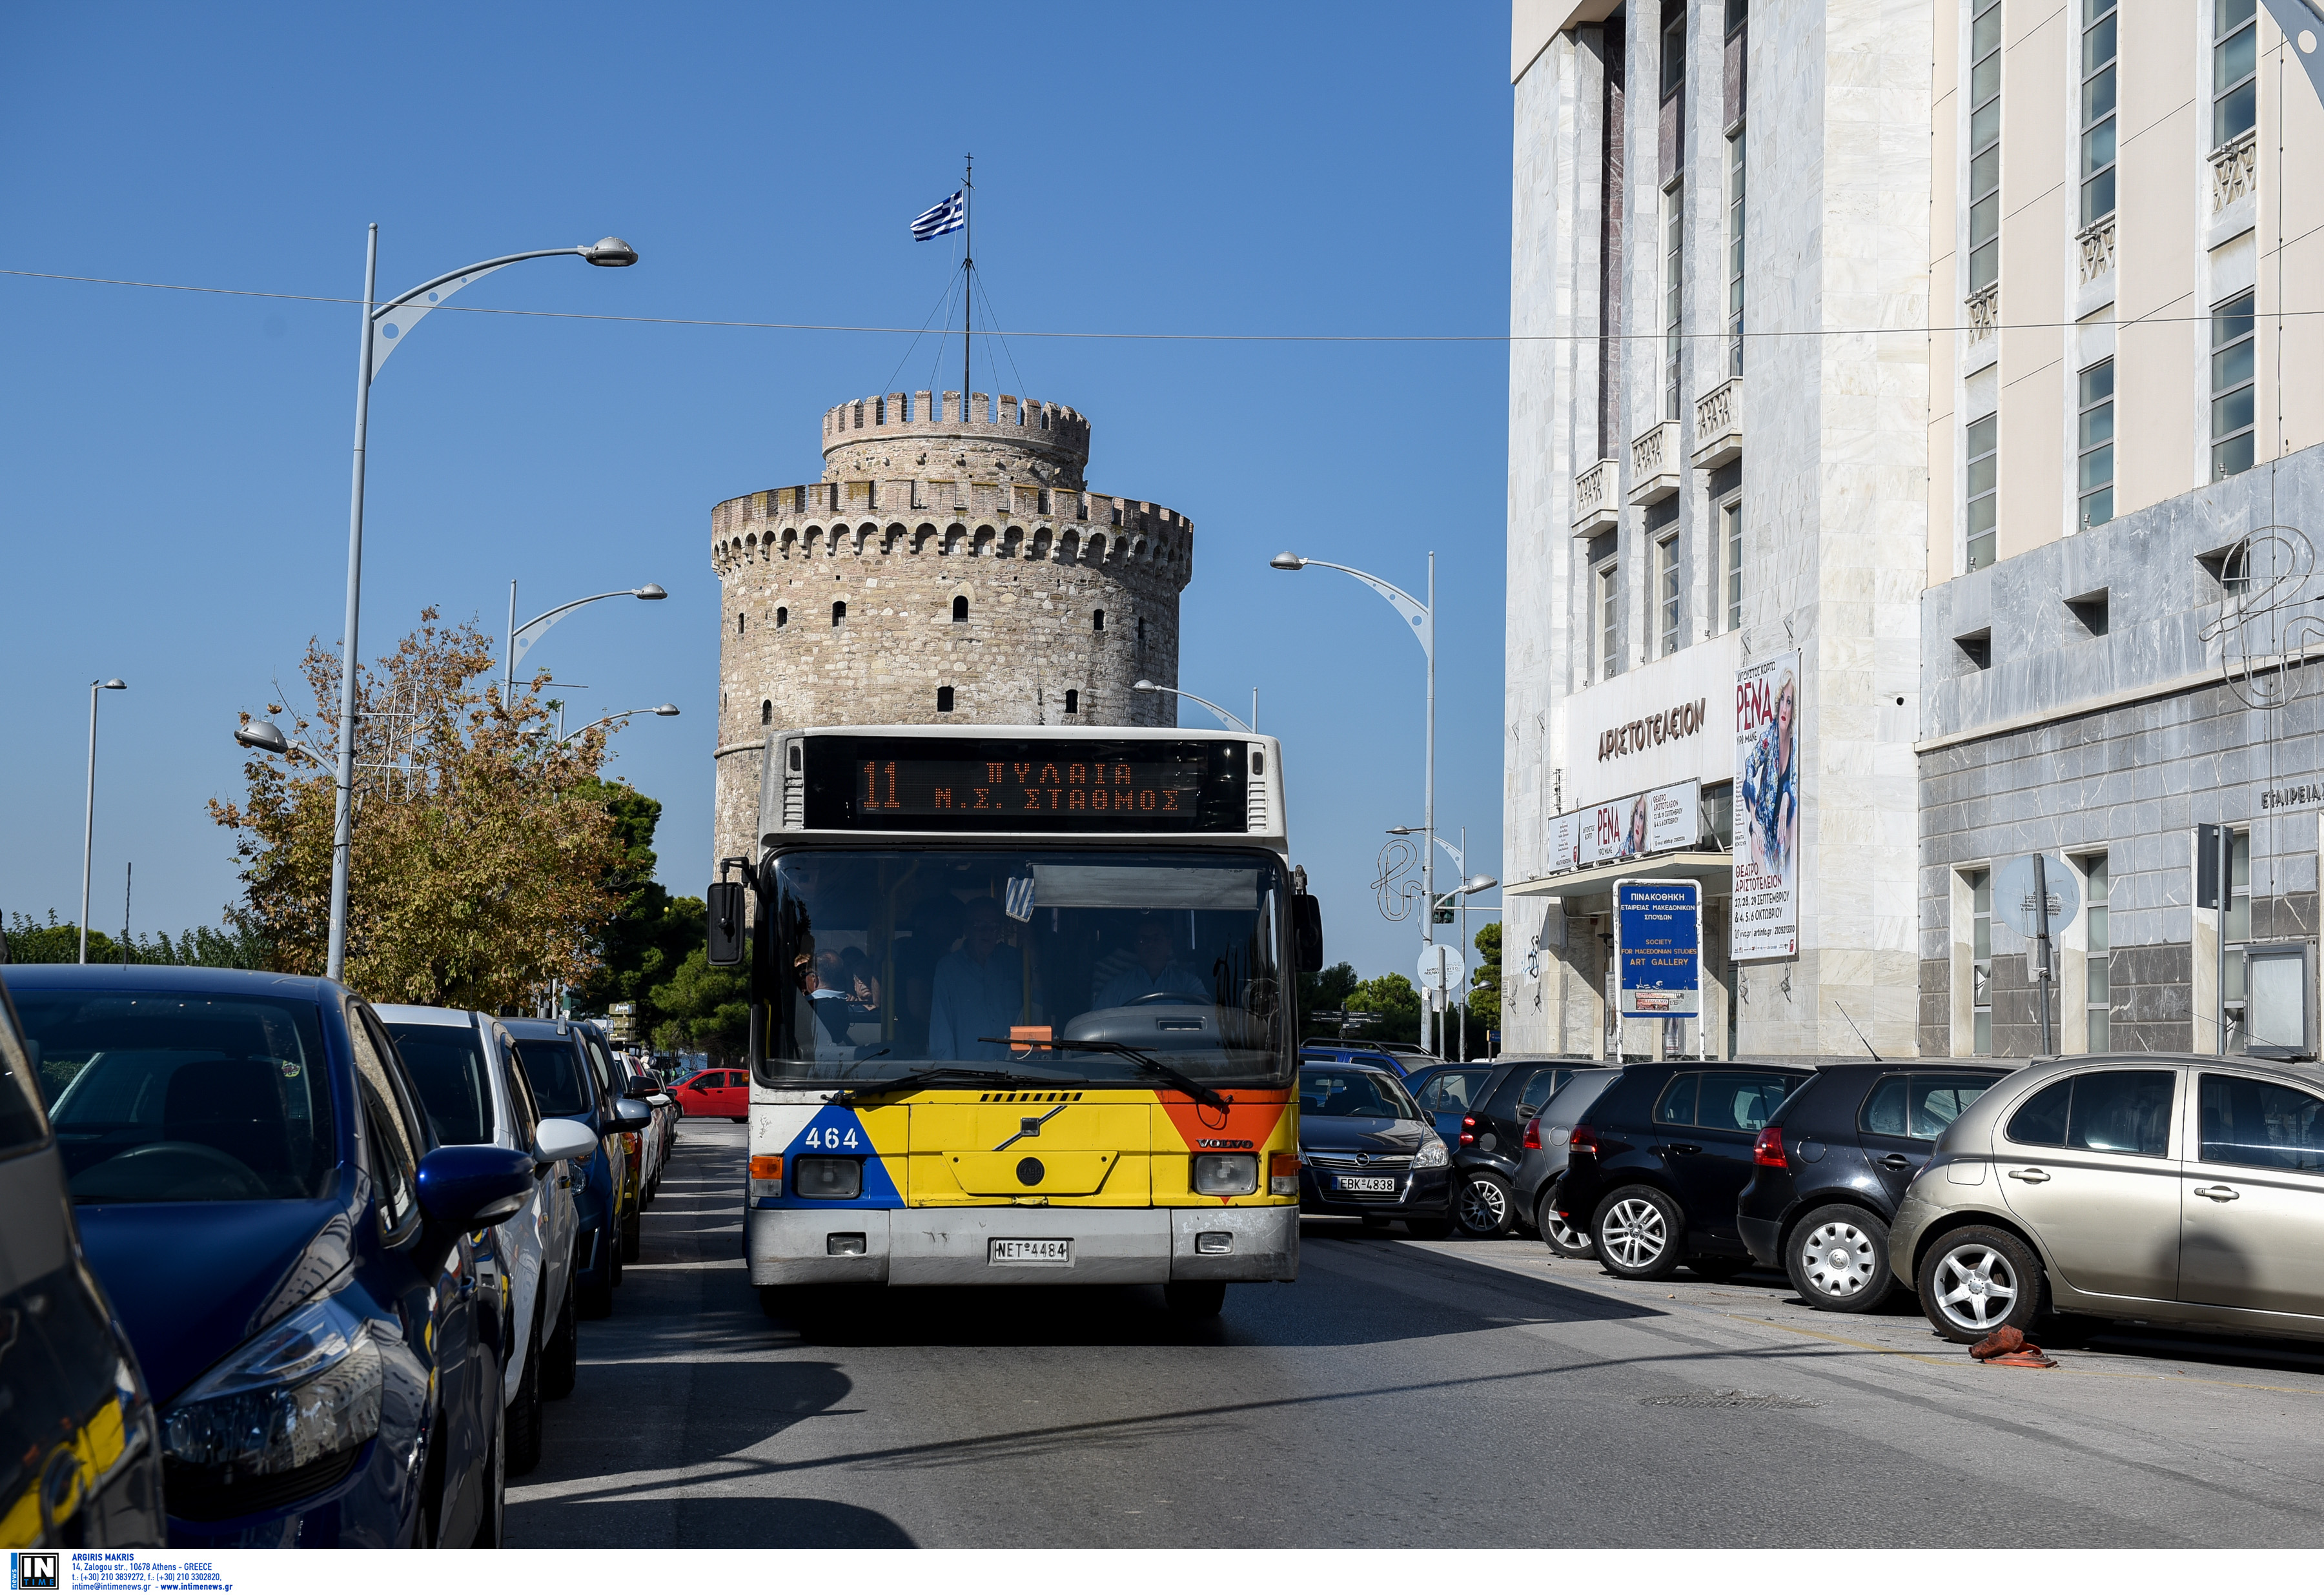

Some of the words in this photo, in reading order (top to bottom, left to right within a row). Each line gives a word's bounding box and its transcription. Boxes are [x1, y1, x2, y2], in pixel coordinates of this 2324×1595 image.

[1737, 666, 1760, 682] ΑΥΓΟΥΣΤΟΣ
[1760, 661, 1776, 675] ΚΟΡΤΩ
[1737, 676, 1773, 733] ΡΕΝΑ
[1598, 697, 1706, 763] ΑΡΙΣΤΟΤΕΛΕΙΟΝ
[1744, 731, 1757, 743] ΜΑΝΕ
[986, 762, 1130, 784] ΠΥΛΑΙΑ
[864, 762, 900, 808] 11
[1024, 789, 1178, 810] ΣΤΑΘΜΟΣ
[1598, 805, 1620, 846] ΡΕΝΑ
[1735, 862, 1759, 878] ΘΕΑΤΡΟ
[1735, 874, 1782, 893] ΑΡΙΣΤΟΤΕΛΕΙΟΝ
[1631, 893, 1685, 901] ΠΙΝΑΚΟΘΗΚΗ
[1742, 896, 1750, 908] 28,
[1751, 896, 1757, 906] 29
[1757, 890, 1789, 905] ΣΕΠΤΕΜΒΡΙΟΥ
[1735, 912, 1739, 923] &
[1751, 911, 1755, 921] 6
[1755, 907, 1783, 920] ΟΚΤΩΒΡΙΟΥ
[1753, 926, 1772, 937] artinfo.gr
[805, 1128, 859, 1149] 464
[1196, 1139, 1254, 1149] VOLVO
